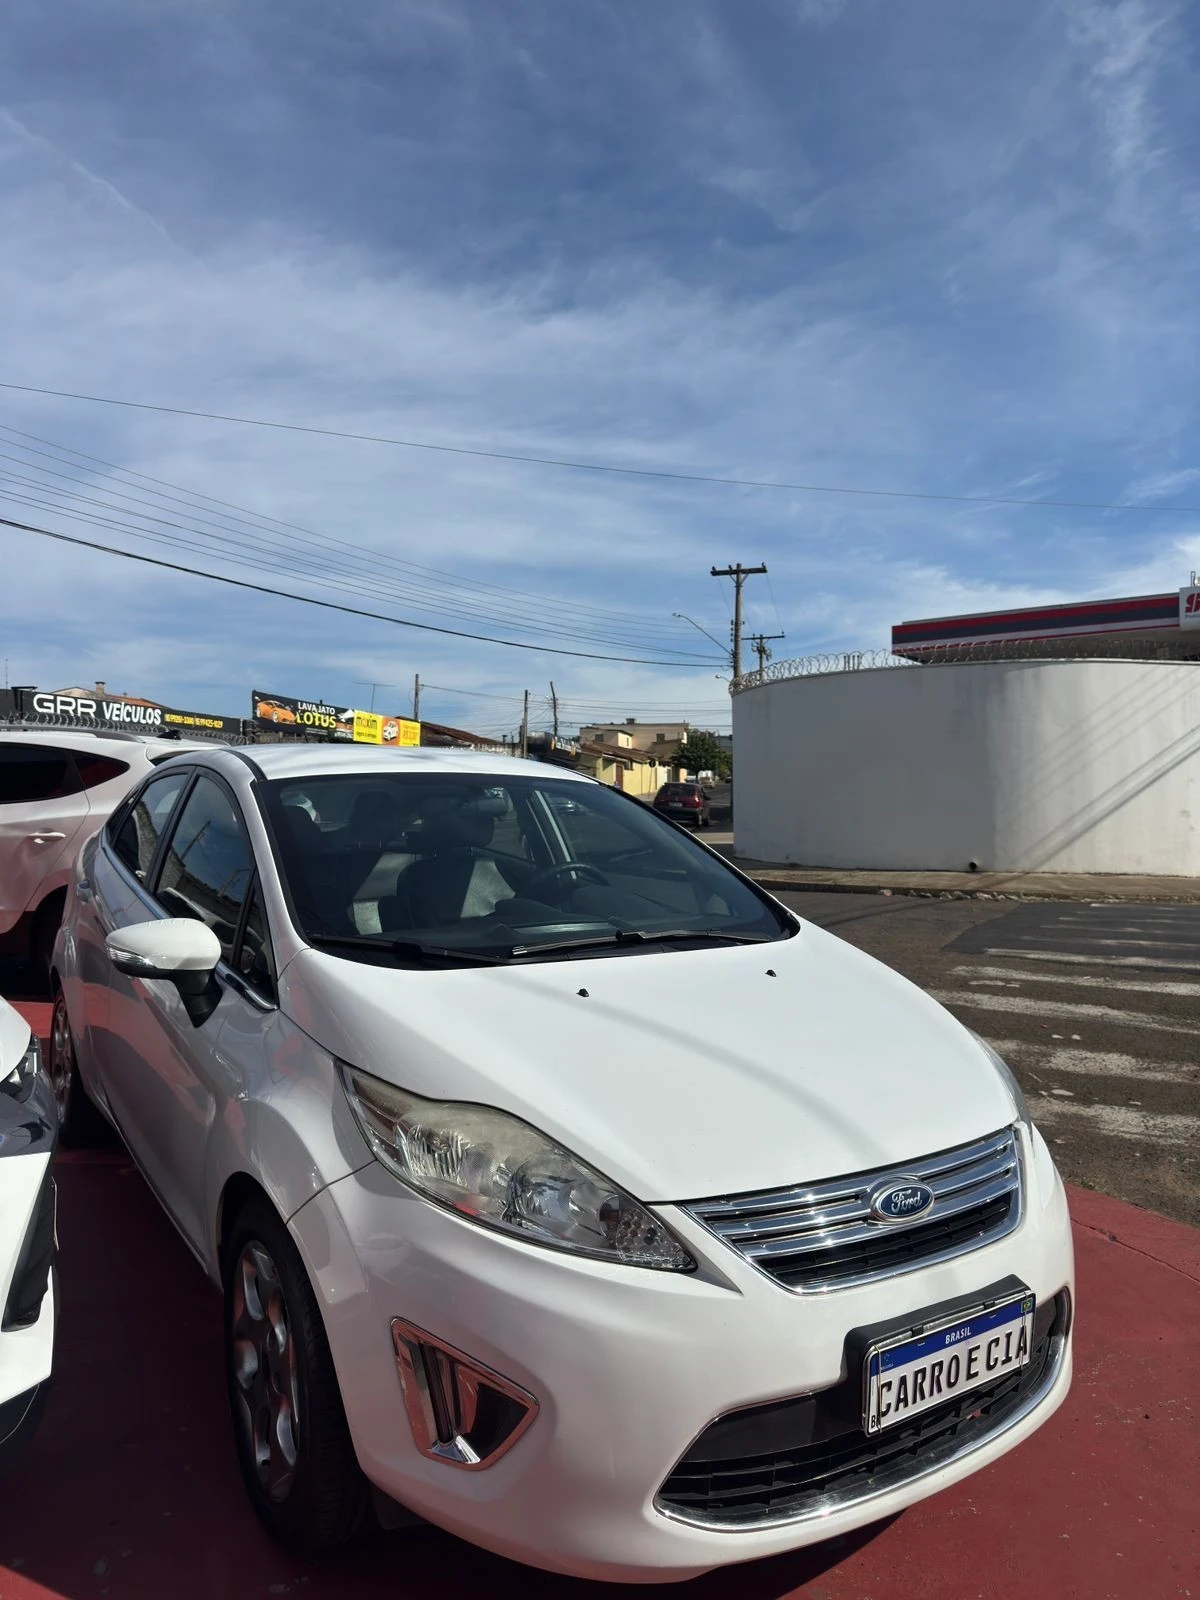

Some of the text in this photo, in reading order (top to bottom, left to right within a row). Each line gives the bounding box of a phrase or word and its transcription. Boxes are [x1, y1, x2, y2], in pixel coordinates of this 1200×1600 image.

[33, 694, 161, 725] GRR VEÍCULOS
[297, 711, 337, 728] LOTUS
[891, 1189, 922, 1213] Ford
[945, 1326, 971, 1344] BRASIL
